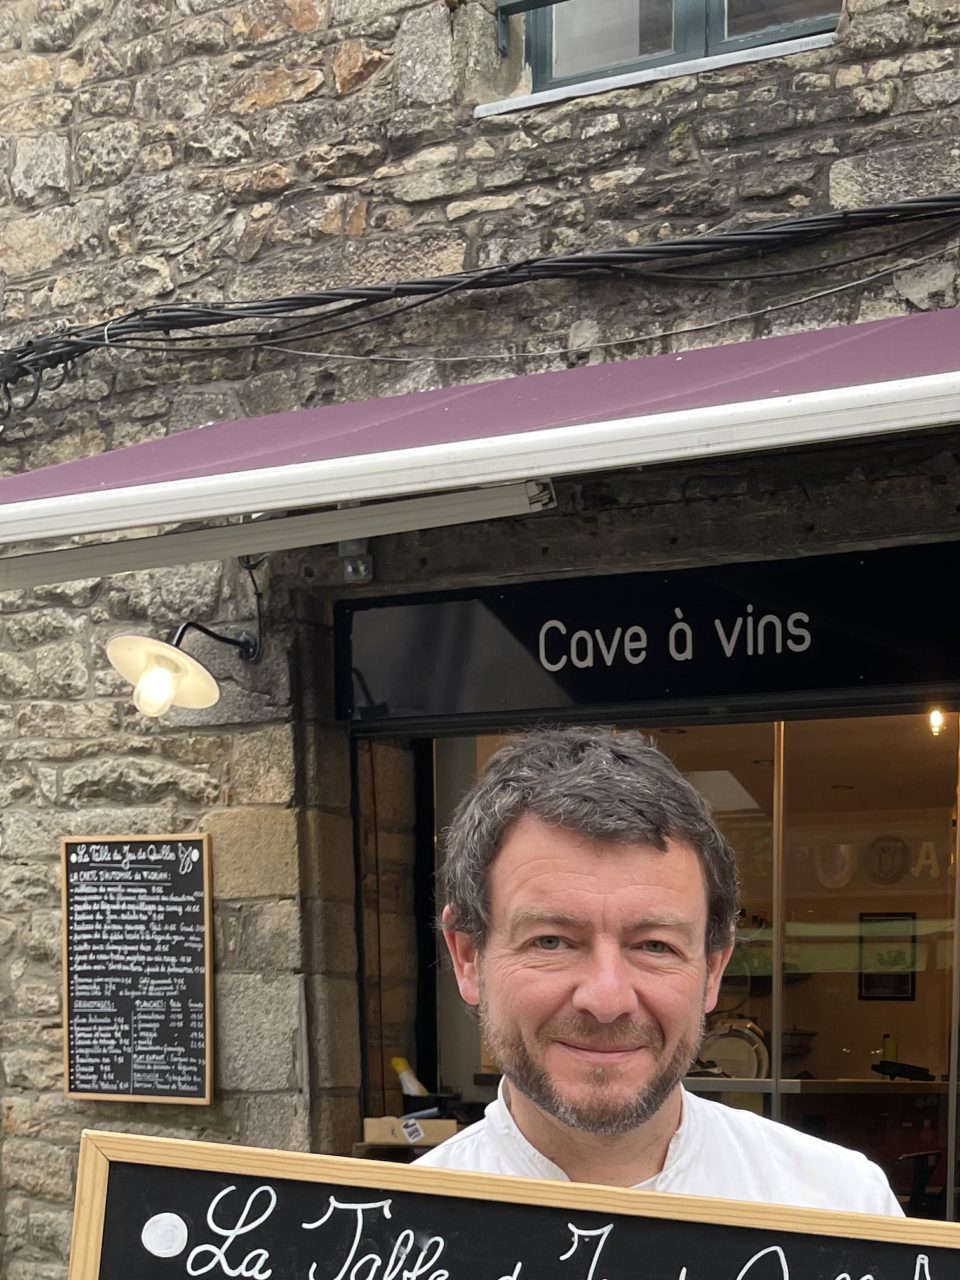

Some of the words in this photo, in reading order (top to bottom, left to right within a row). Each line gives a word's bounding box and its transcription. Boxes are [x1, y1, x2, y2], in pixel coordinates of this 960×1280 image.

[539, 619, 647, 672] Cave
[669, 607, 692, 661] à
[714, 604, 812, 658] vins
[186, 1185, 277, 1280] La
